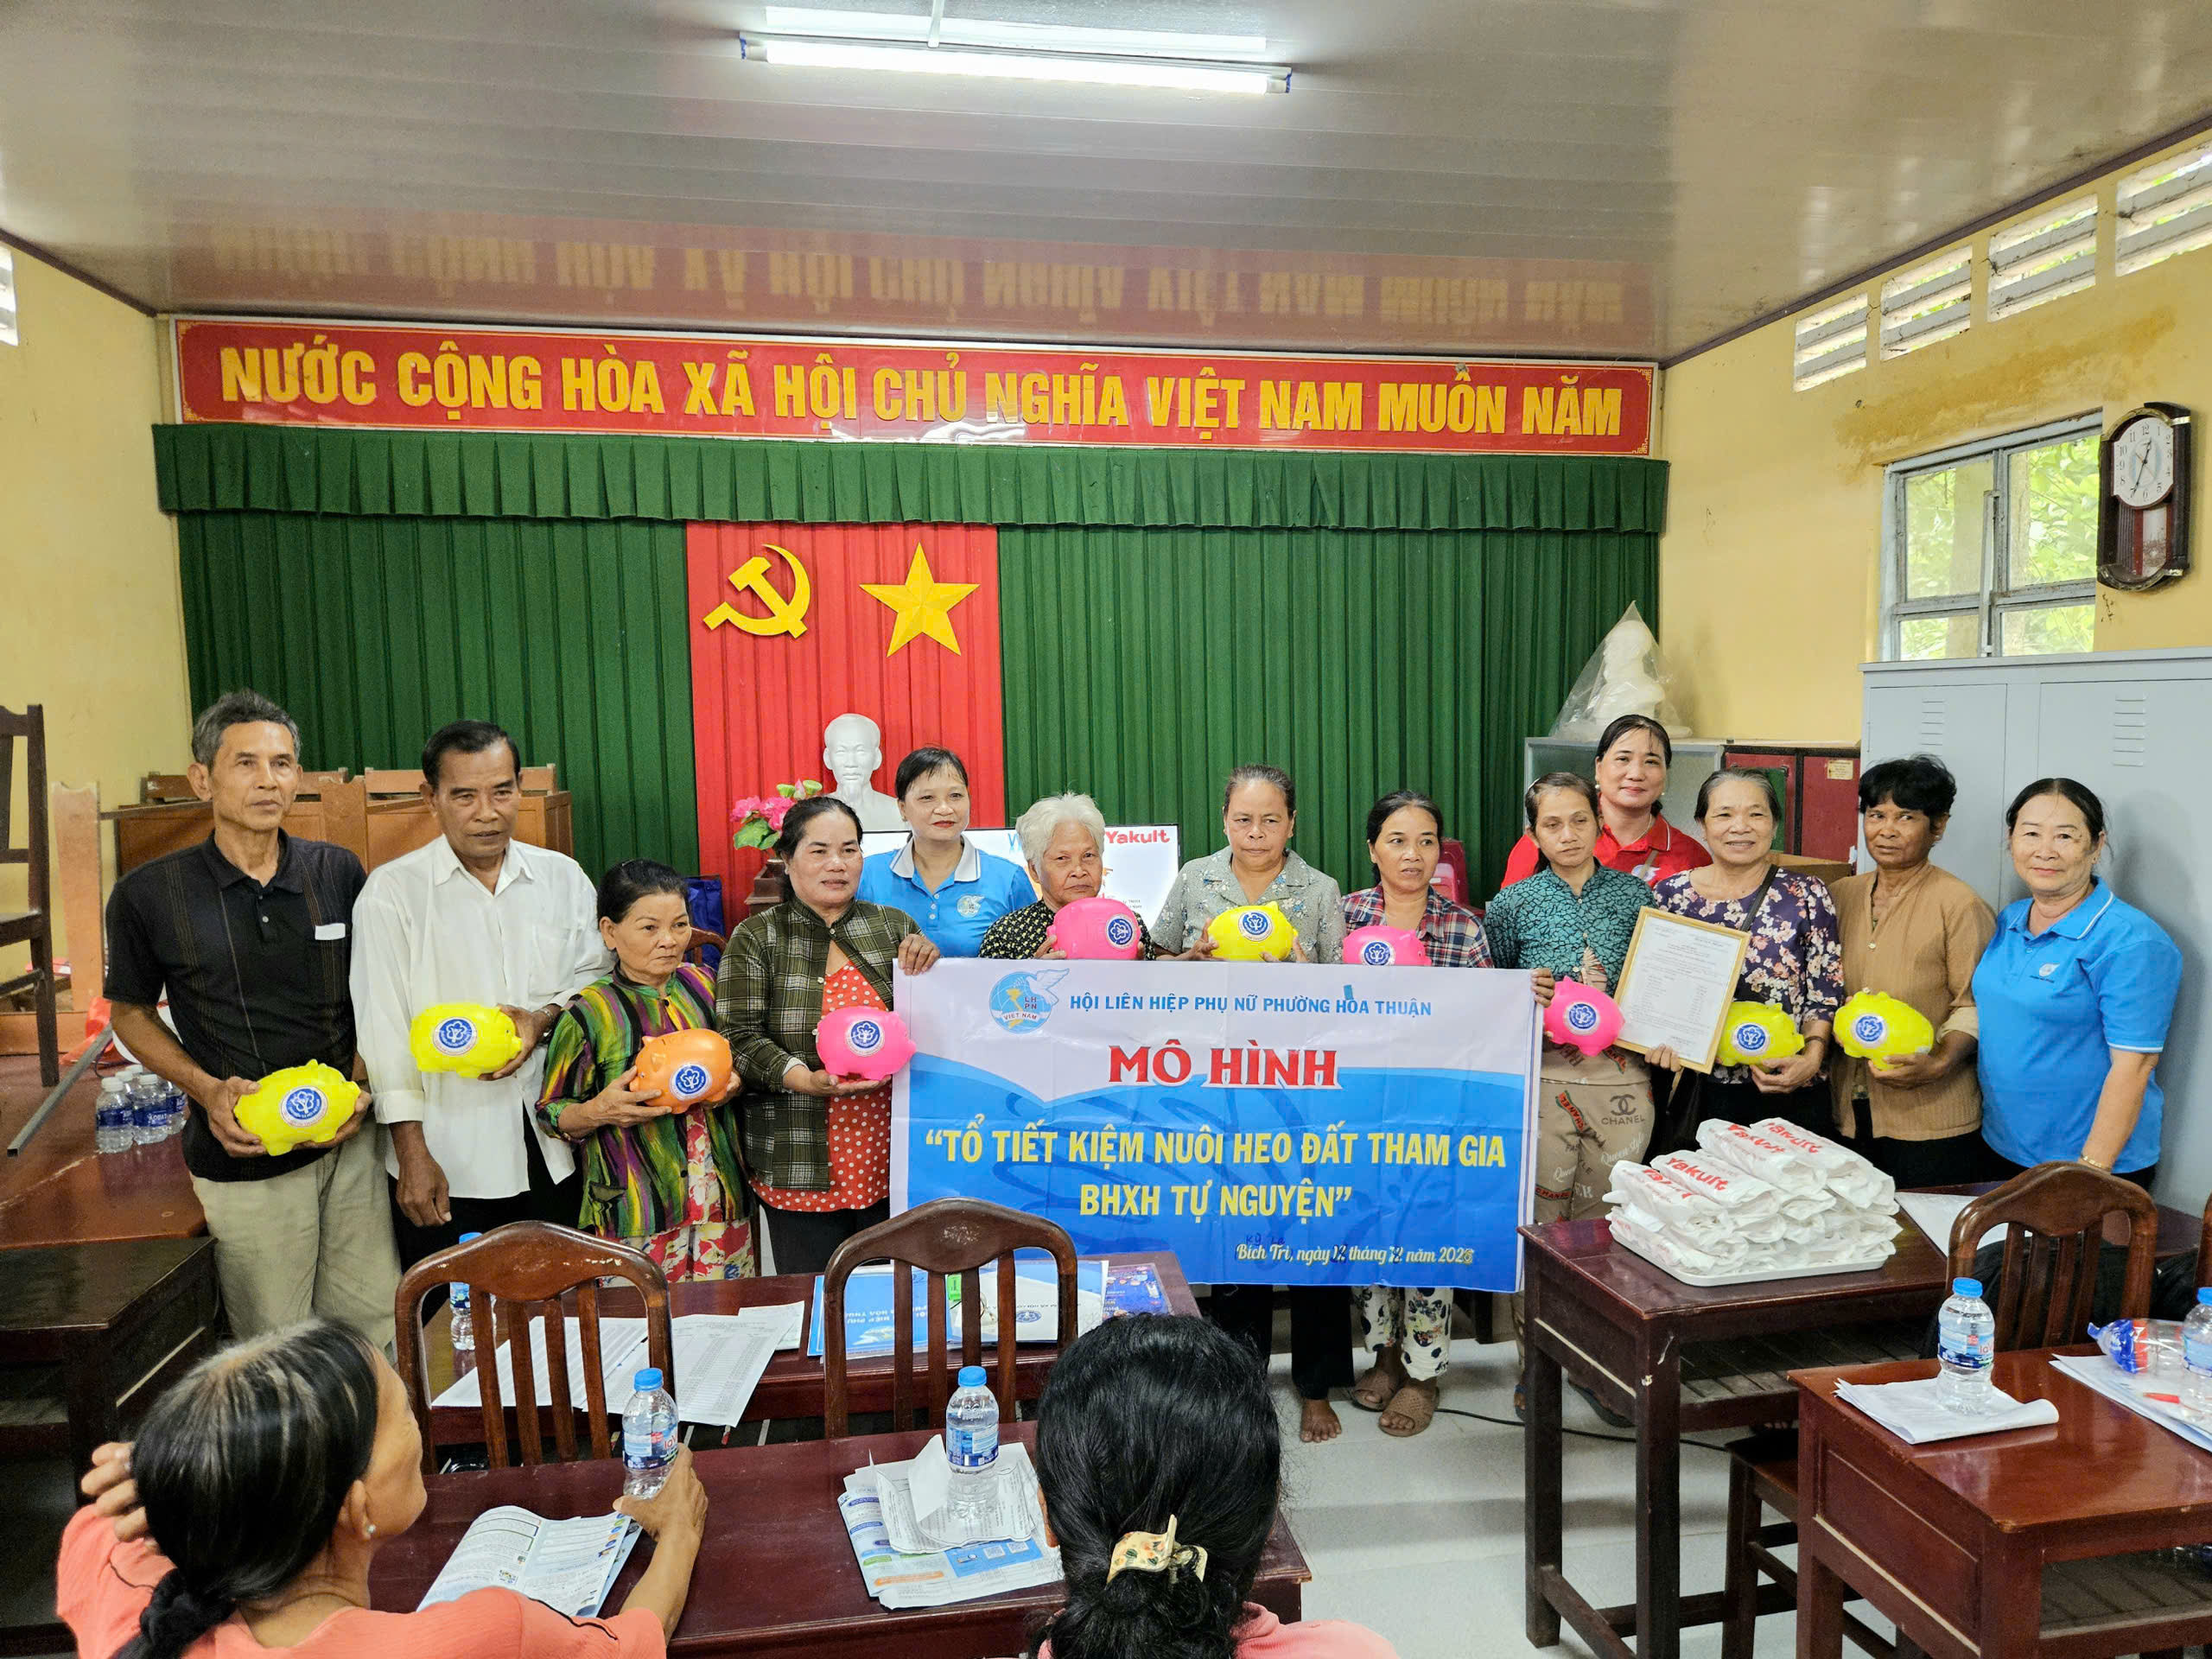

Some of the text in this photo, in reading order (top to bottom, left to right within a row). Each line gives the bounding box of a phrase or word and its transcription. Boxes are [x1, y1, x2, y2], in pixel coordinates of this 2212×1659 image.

[221, 336, 1622, 440] NƯỚC CỘNG HÒA XÃ HỘI CHỦ NGHĨA VIỆT NAM MUÔN NĂM
[1105, 830, 1171, 844] Yakult
[1070, 992, 1099, 1013] HỘI
[1105, 992, 1144, 1010] LIÊN
[1149, 992, 1190, 1013] HIỆP
[1194, 996, 1228, 1014] PHỤ
[1234, 994, 1258, 1012] NỮ
[1263, 995, 1332, 1014] PHƯỜNG
[1375, 997, 1432, 1018] THUẬN
[1109, 1039, 1338, 1086] MÔ HÌNH
[1600, 1114, 1645, 1125] CHANEL
[992, 1119, 1058, 1163] TIẾT
[1068, 1123, 1144, 1170] KIỆM
[1154, 1123, 1224, 1164] NUÔI
[1233, 1133, 1292, 1163] HEO
[1301, 1120, 1358, 1164] ĐẤT
[1367, 1133, 1451, 1166] THAM
[1458, 1135, 1506, 1167] GIA
[1666, 1157, 1728, 1191] Yakult
[1080, 1178, 1352, 1224] BHXH TỰ NGUYỆN”
[1236, 1243, 1268, 1260] Bích
[1296, 1249, 1331, 1266] ngày
[1349, 1246, 1387, 1266] tháng
[1406, 1248, 1436, 1262] năm
